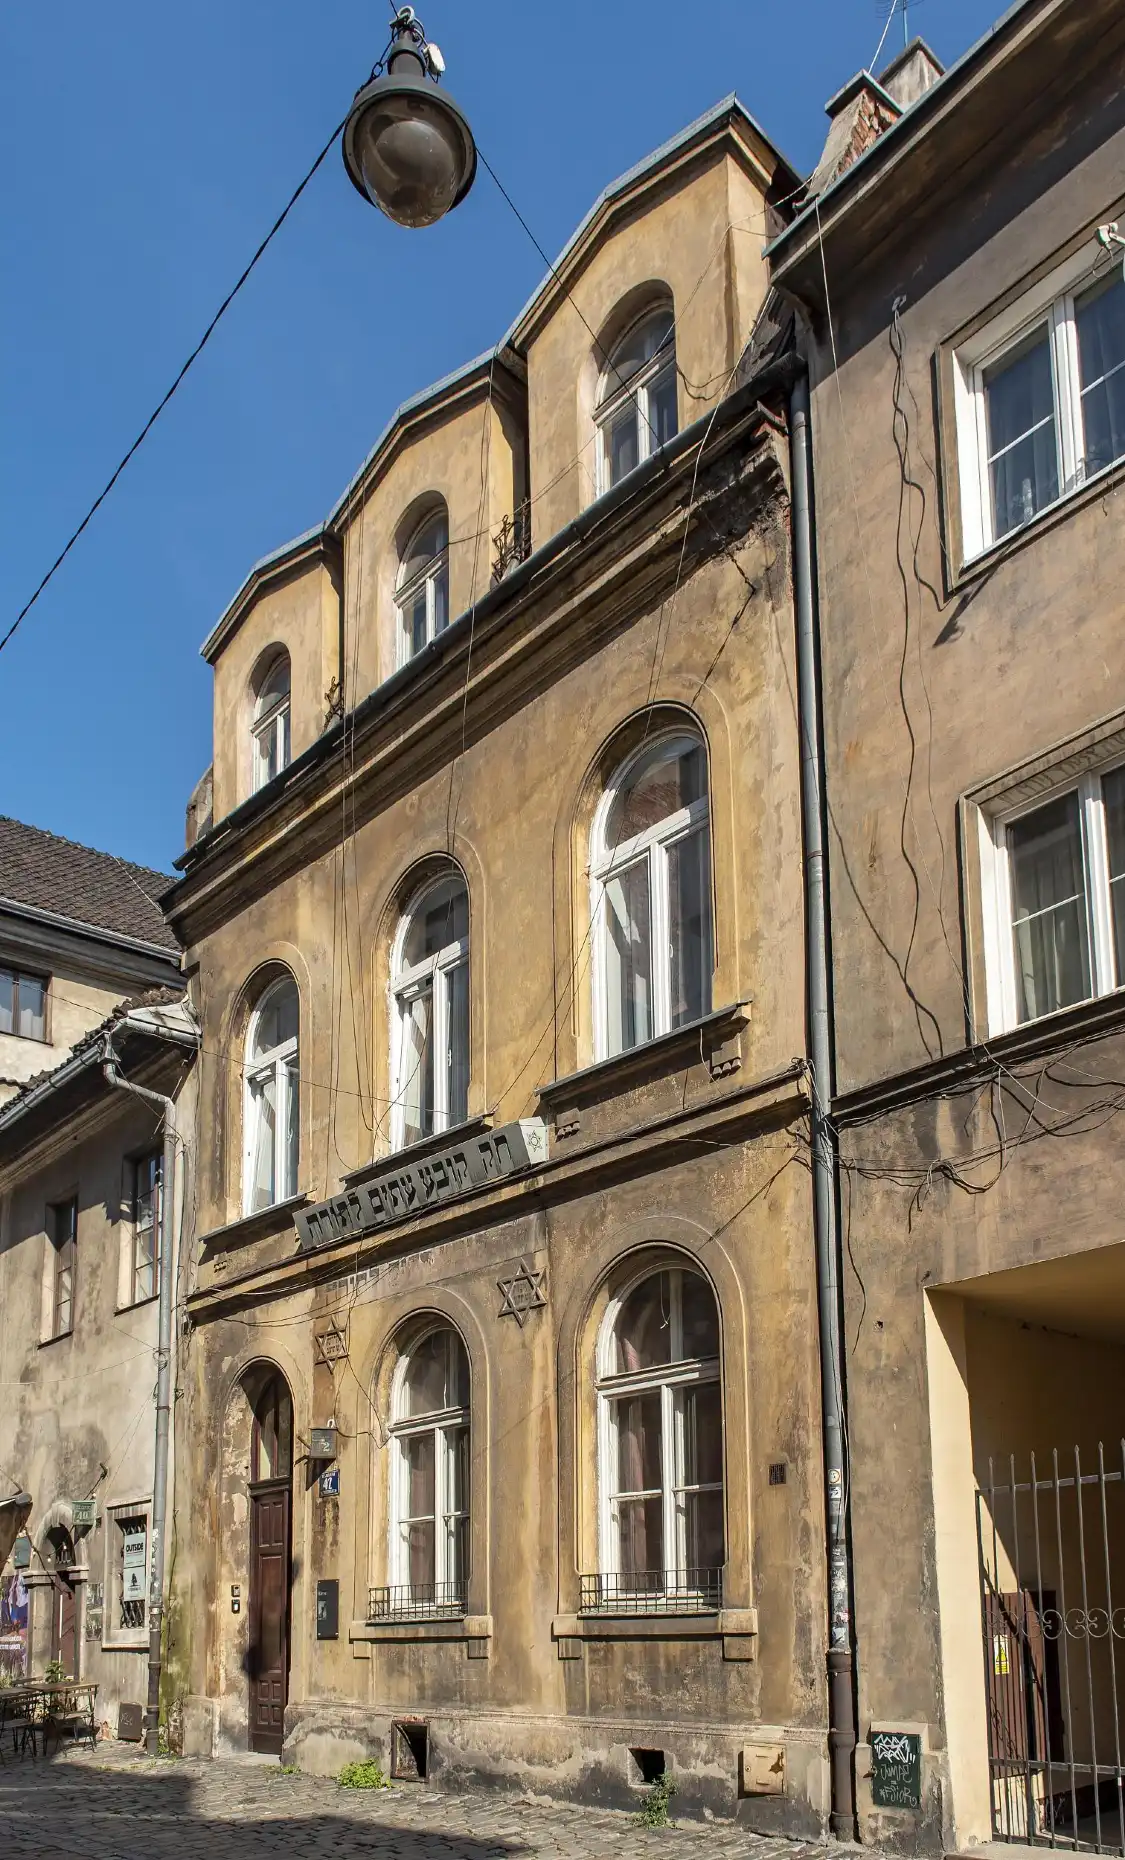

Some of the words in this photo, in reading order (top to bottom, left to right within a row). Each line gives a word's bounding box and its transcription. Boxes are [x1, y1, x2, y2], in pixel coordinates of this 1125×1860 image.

[478, 1135, 512, 1174] חק
[417, 1152, 467, 1200] קובע
[126, 1542, 144, 1552] OUTSIDE
